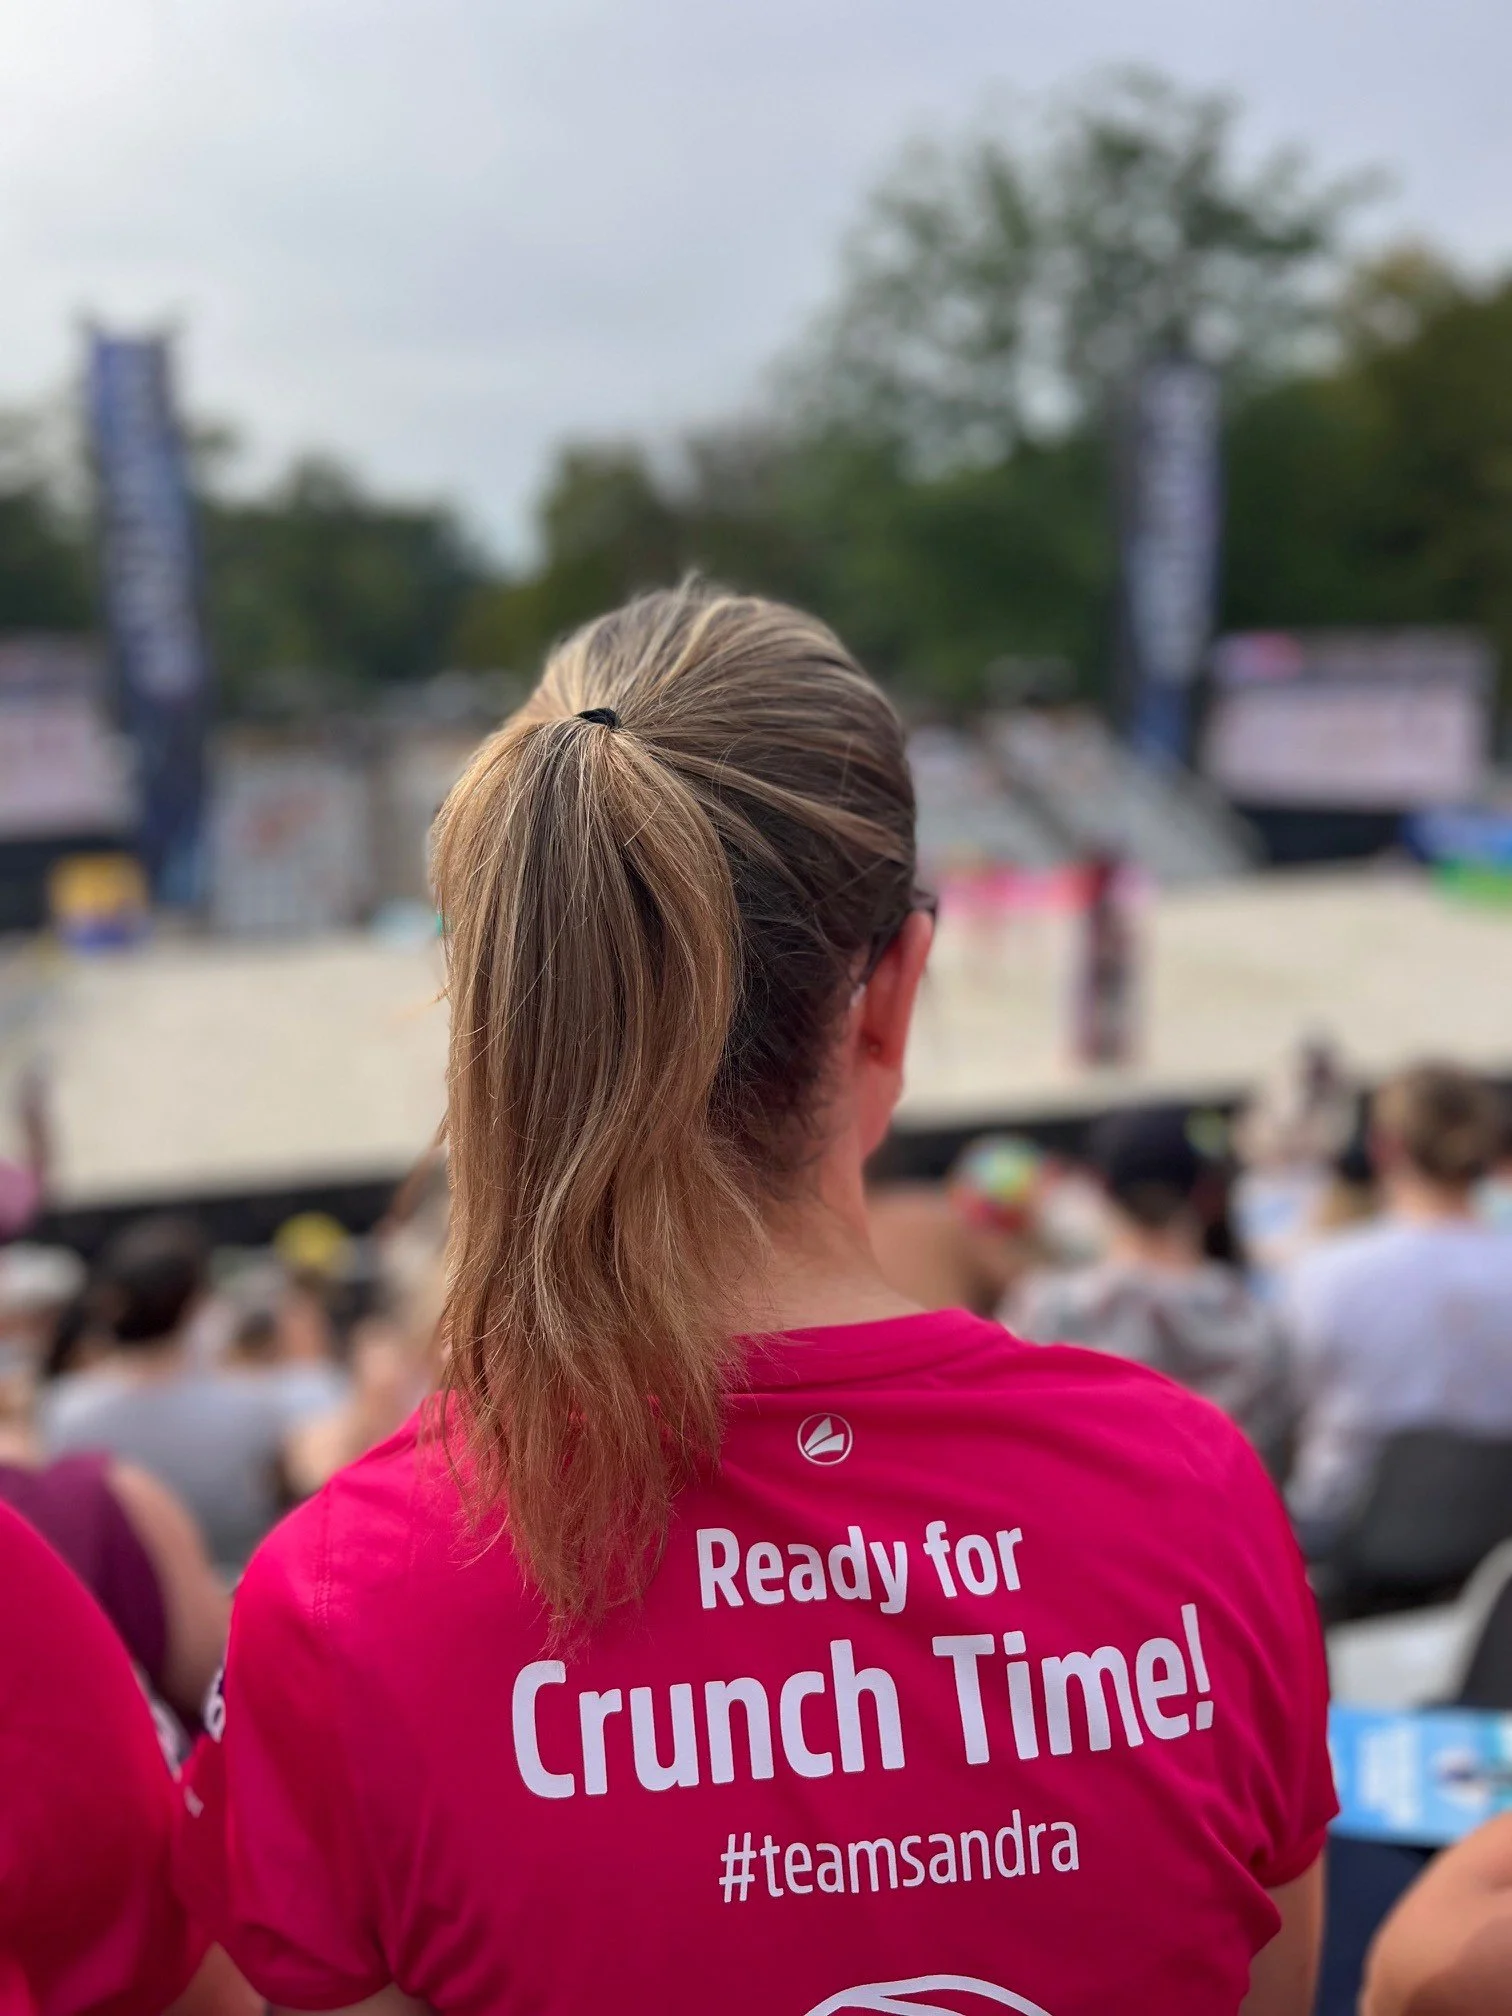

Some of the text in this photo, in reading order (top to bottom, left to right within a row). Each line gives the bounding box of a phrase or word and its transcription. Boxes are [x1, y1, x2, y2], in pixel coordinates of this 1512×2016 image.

[696, 1520, 1023, 1614] Ready for
[512, 1603, 1214, 1799] Crunch Time!
[718, 1808, 1080, 1903] #teamsandra
